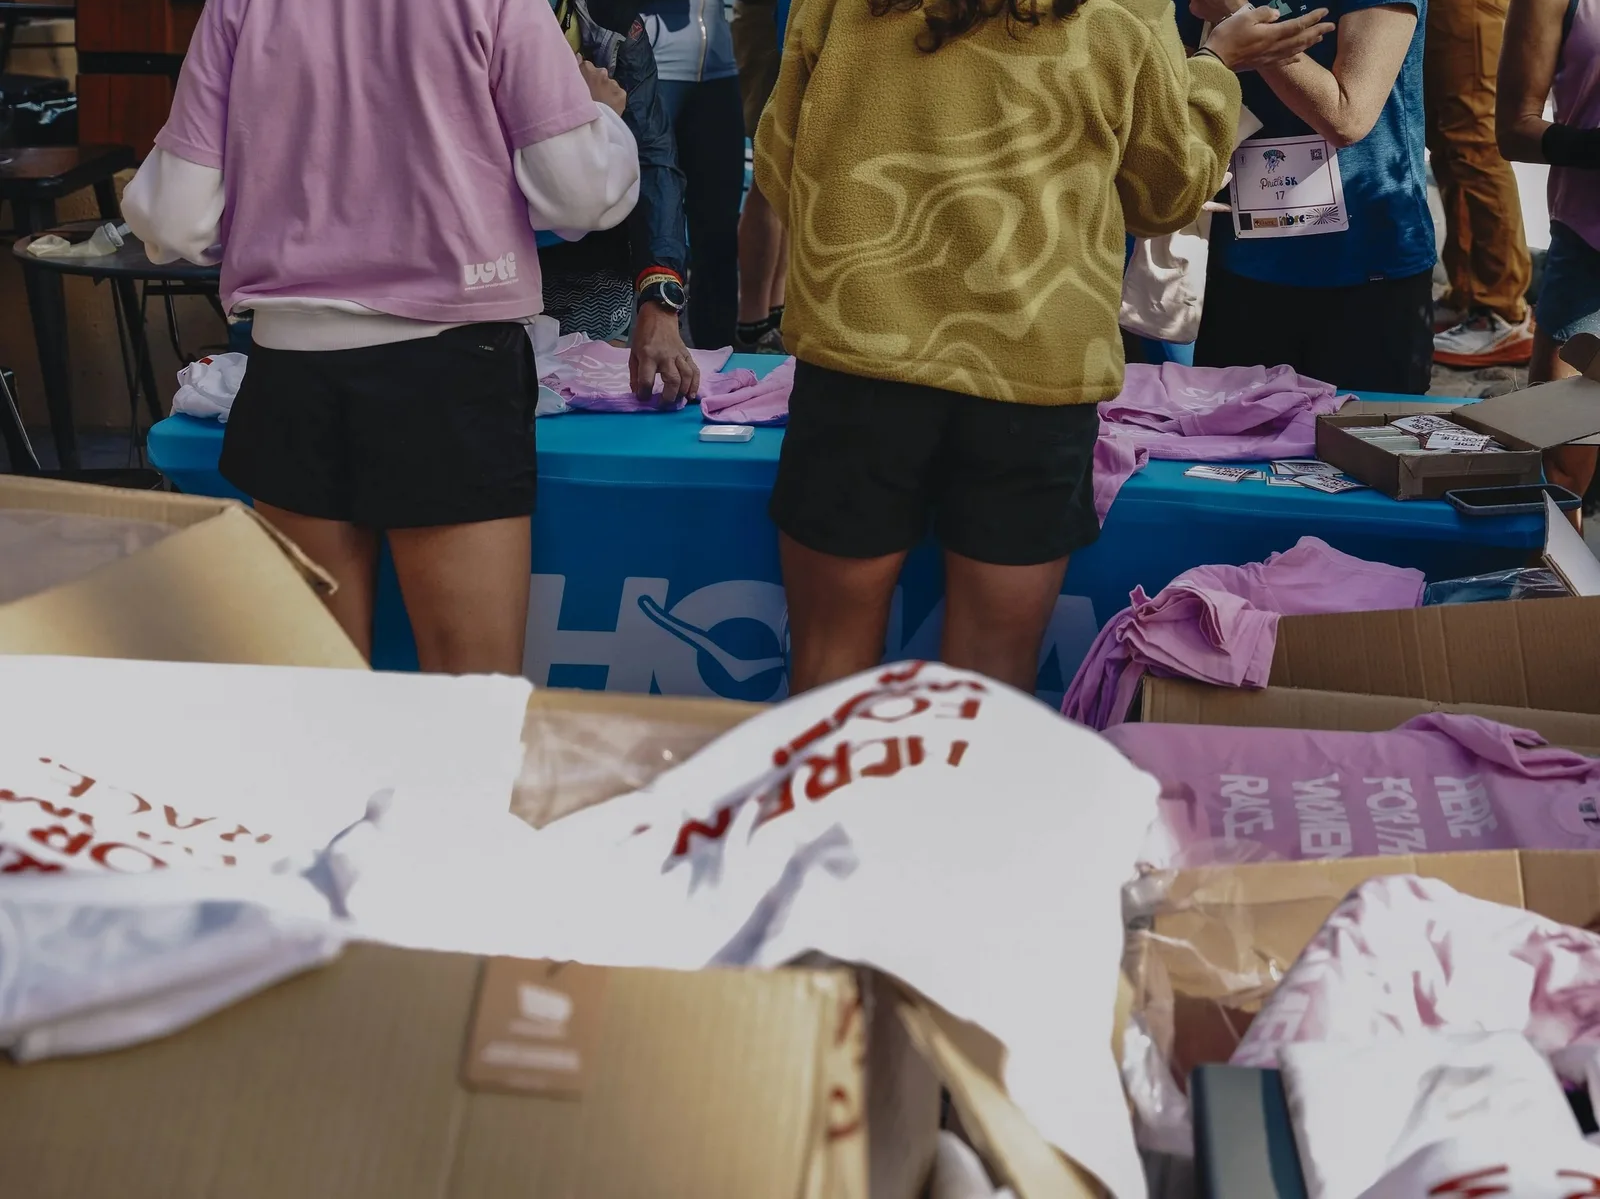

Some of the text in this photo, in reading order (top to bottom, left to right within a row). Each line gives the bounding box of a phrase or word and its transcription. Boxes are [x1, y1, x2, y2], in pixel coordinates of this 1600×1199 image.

[1275, 190, 1285, 200] 17
[1285, 176, 1298, 186] 5K
[1220, 774, 1275, 847] RACE
[1363, 777, 1428, 856] FOR TH
[1434, 773, 1498, 838] HERE
